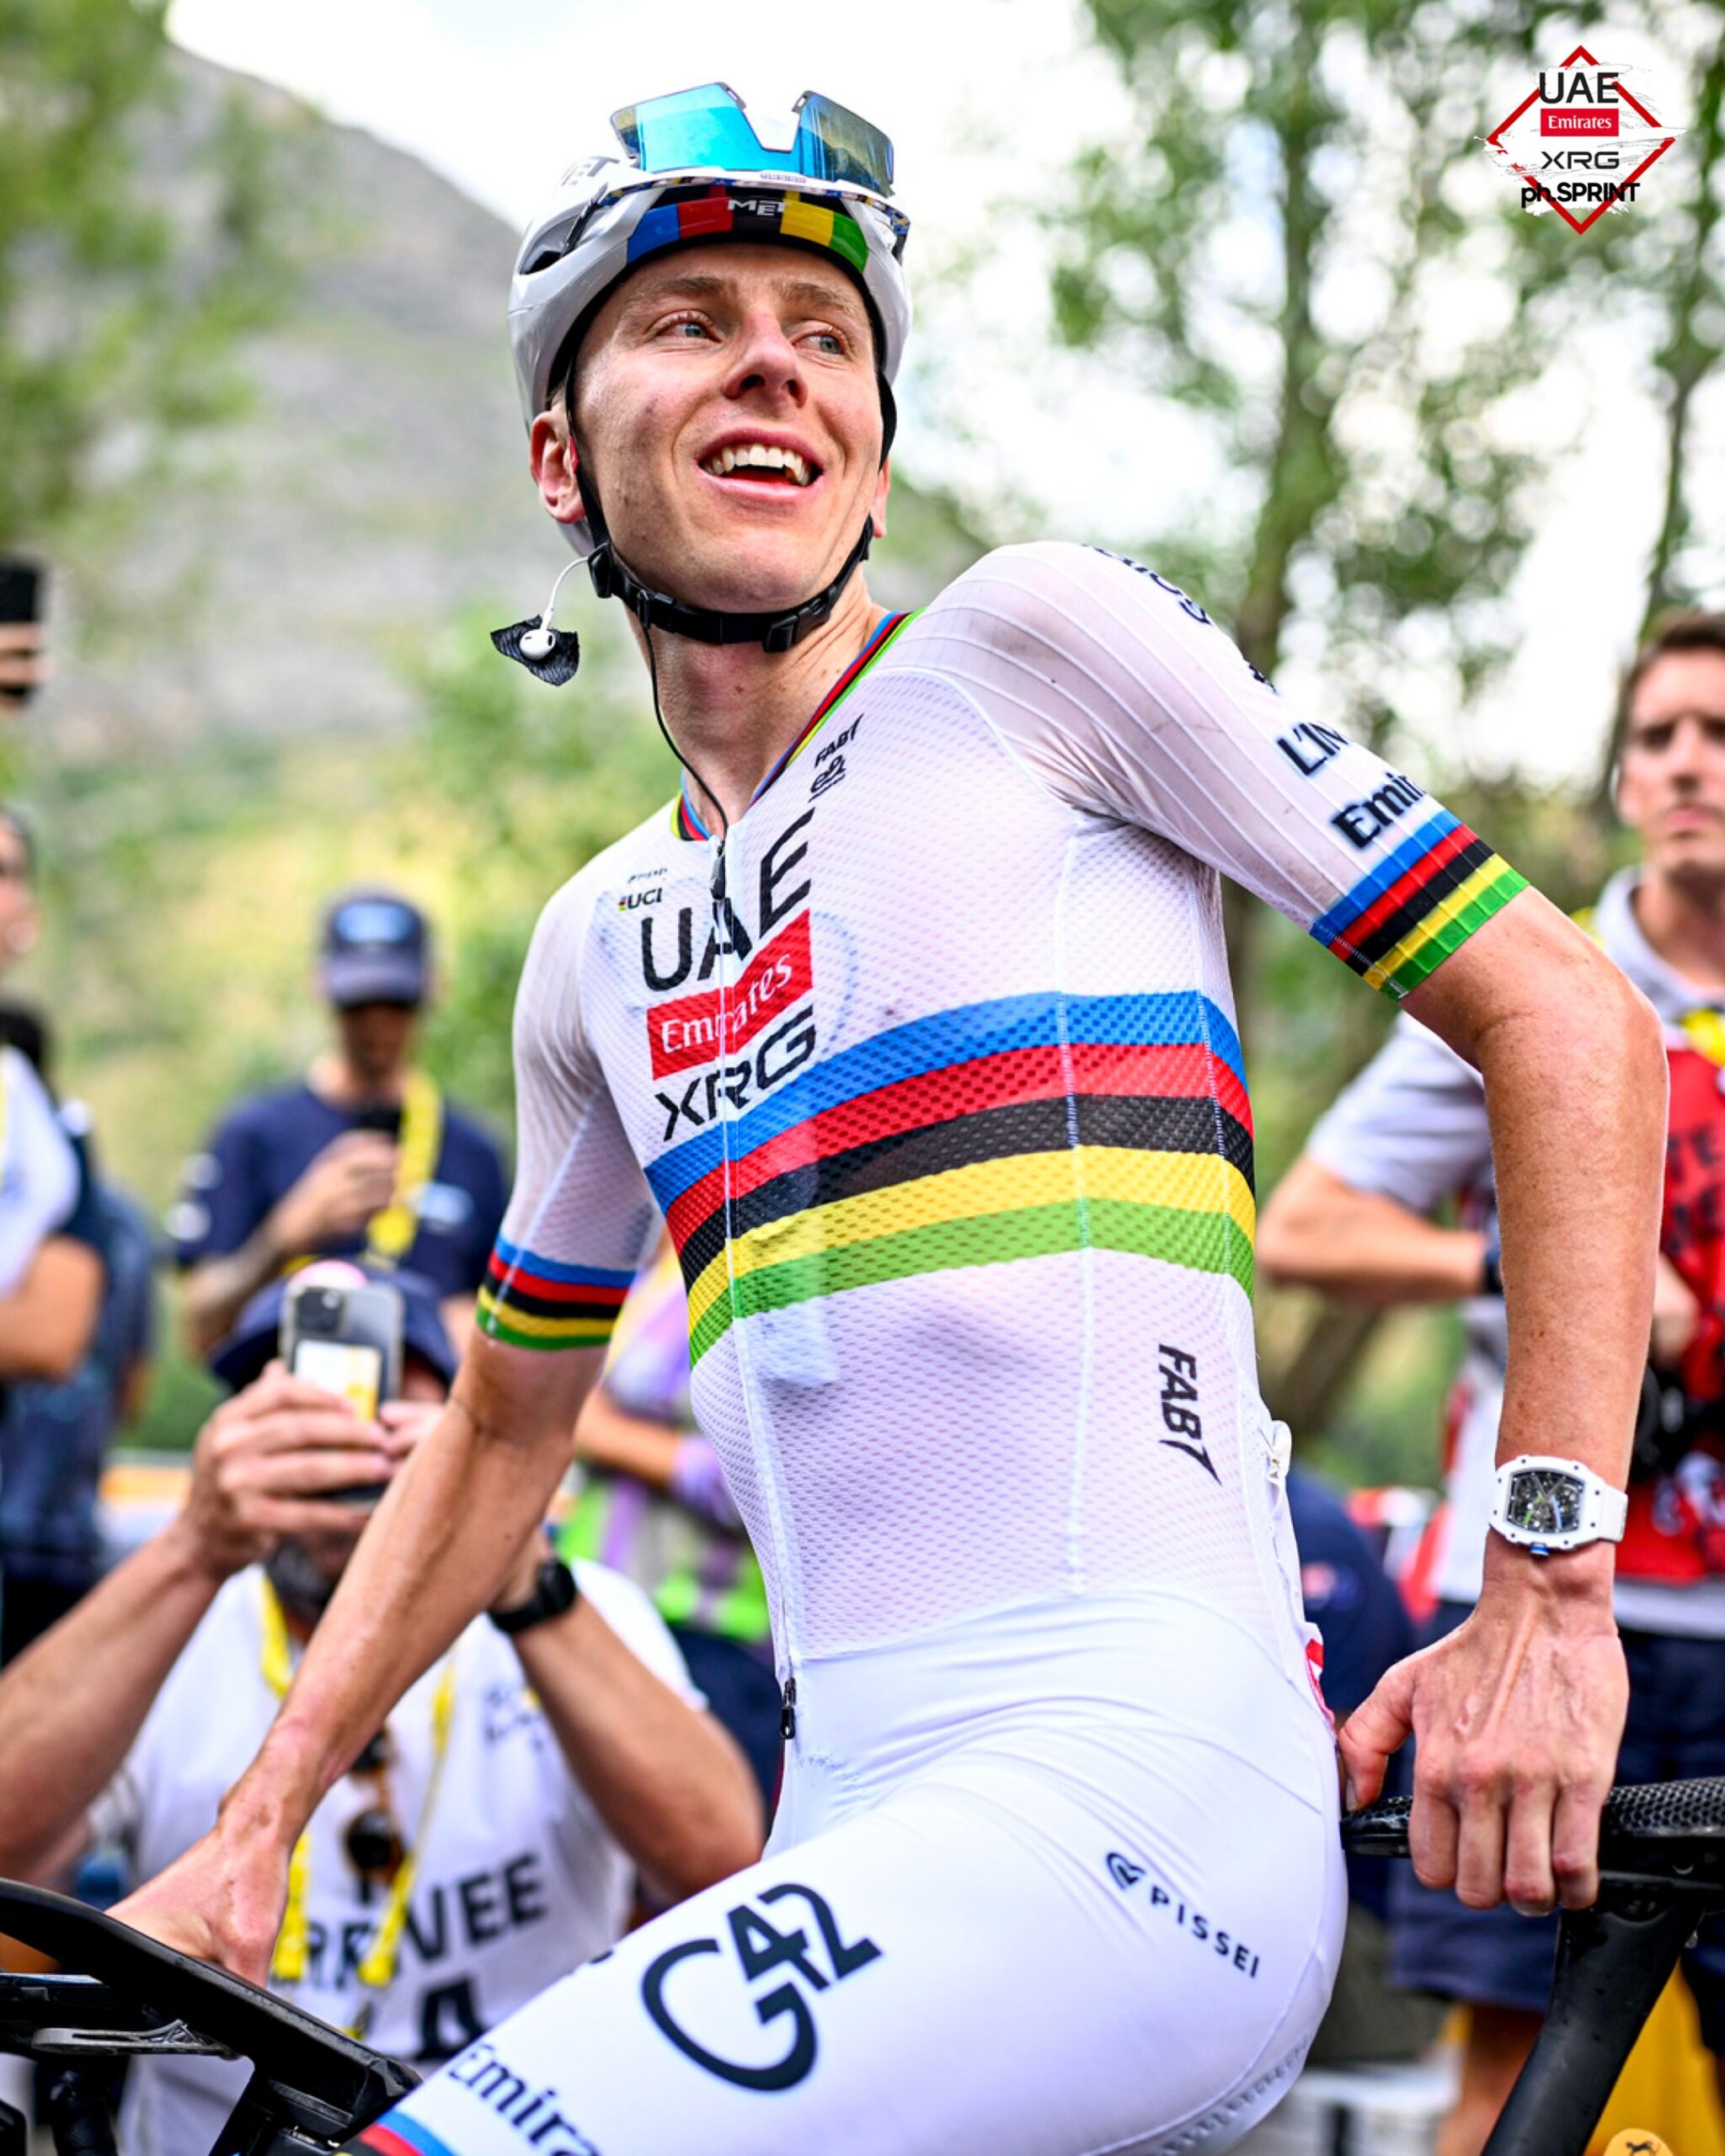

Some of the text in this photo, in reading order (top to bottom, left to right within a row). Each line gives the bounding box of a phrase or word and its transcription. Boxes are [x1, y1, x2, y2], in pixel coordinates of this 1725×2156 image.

[628, 887, 663, 910] UCI
[640, 806, 815, 992] UAE
[654, 1005, 816, 1142] XRG
[641, 1882, 883, 2094] G42
[1151, 1884, 1260, 1979] PISSEI
